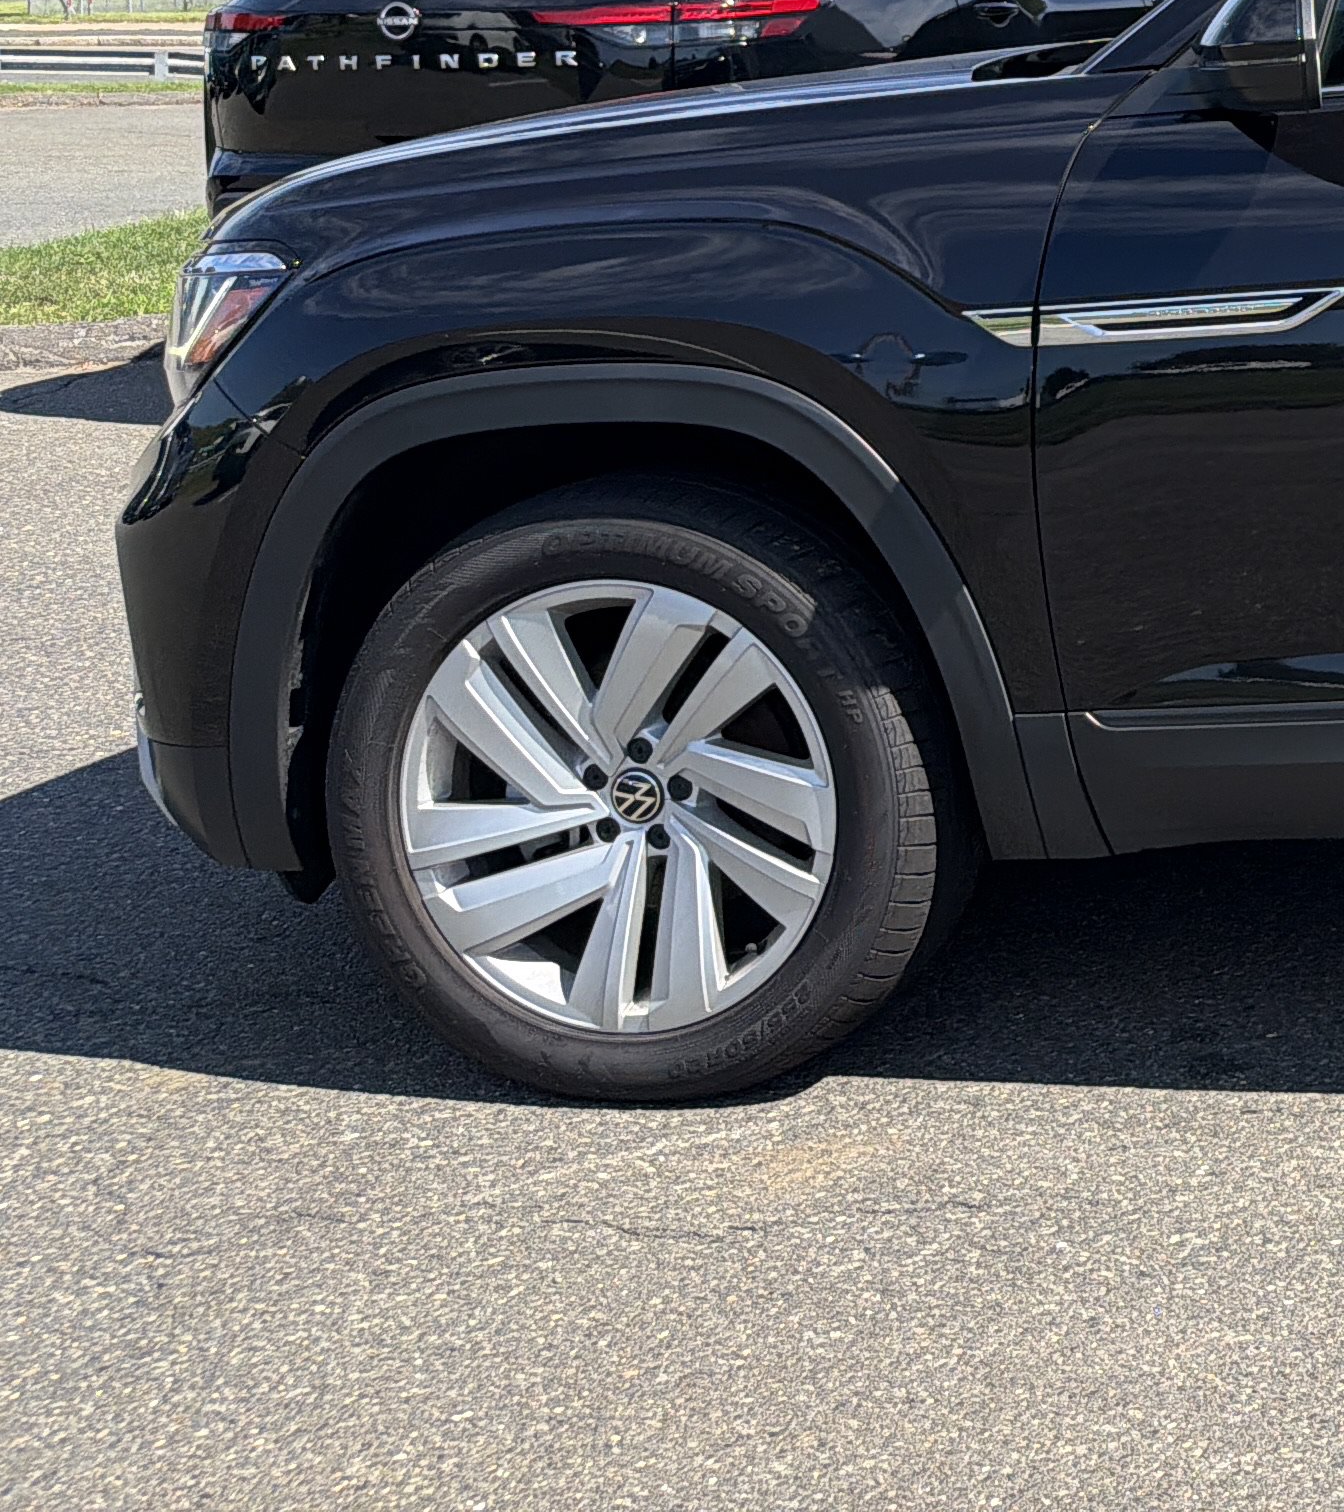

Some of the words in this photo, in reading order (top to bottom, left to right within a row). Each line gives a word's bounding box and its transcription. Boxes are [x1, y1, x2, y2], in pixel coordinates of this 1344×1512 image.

[377, 16, 419, 26] NISSAN
[250, 50, 578, 72] PATHFINDER
[836, 687, 864, 726] HP
